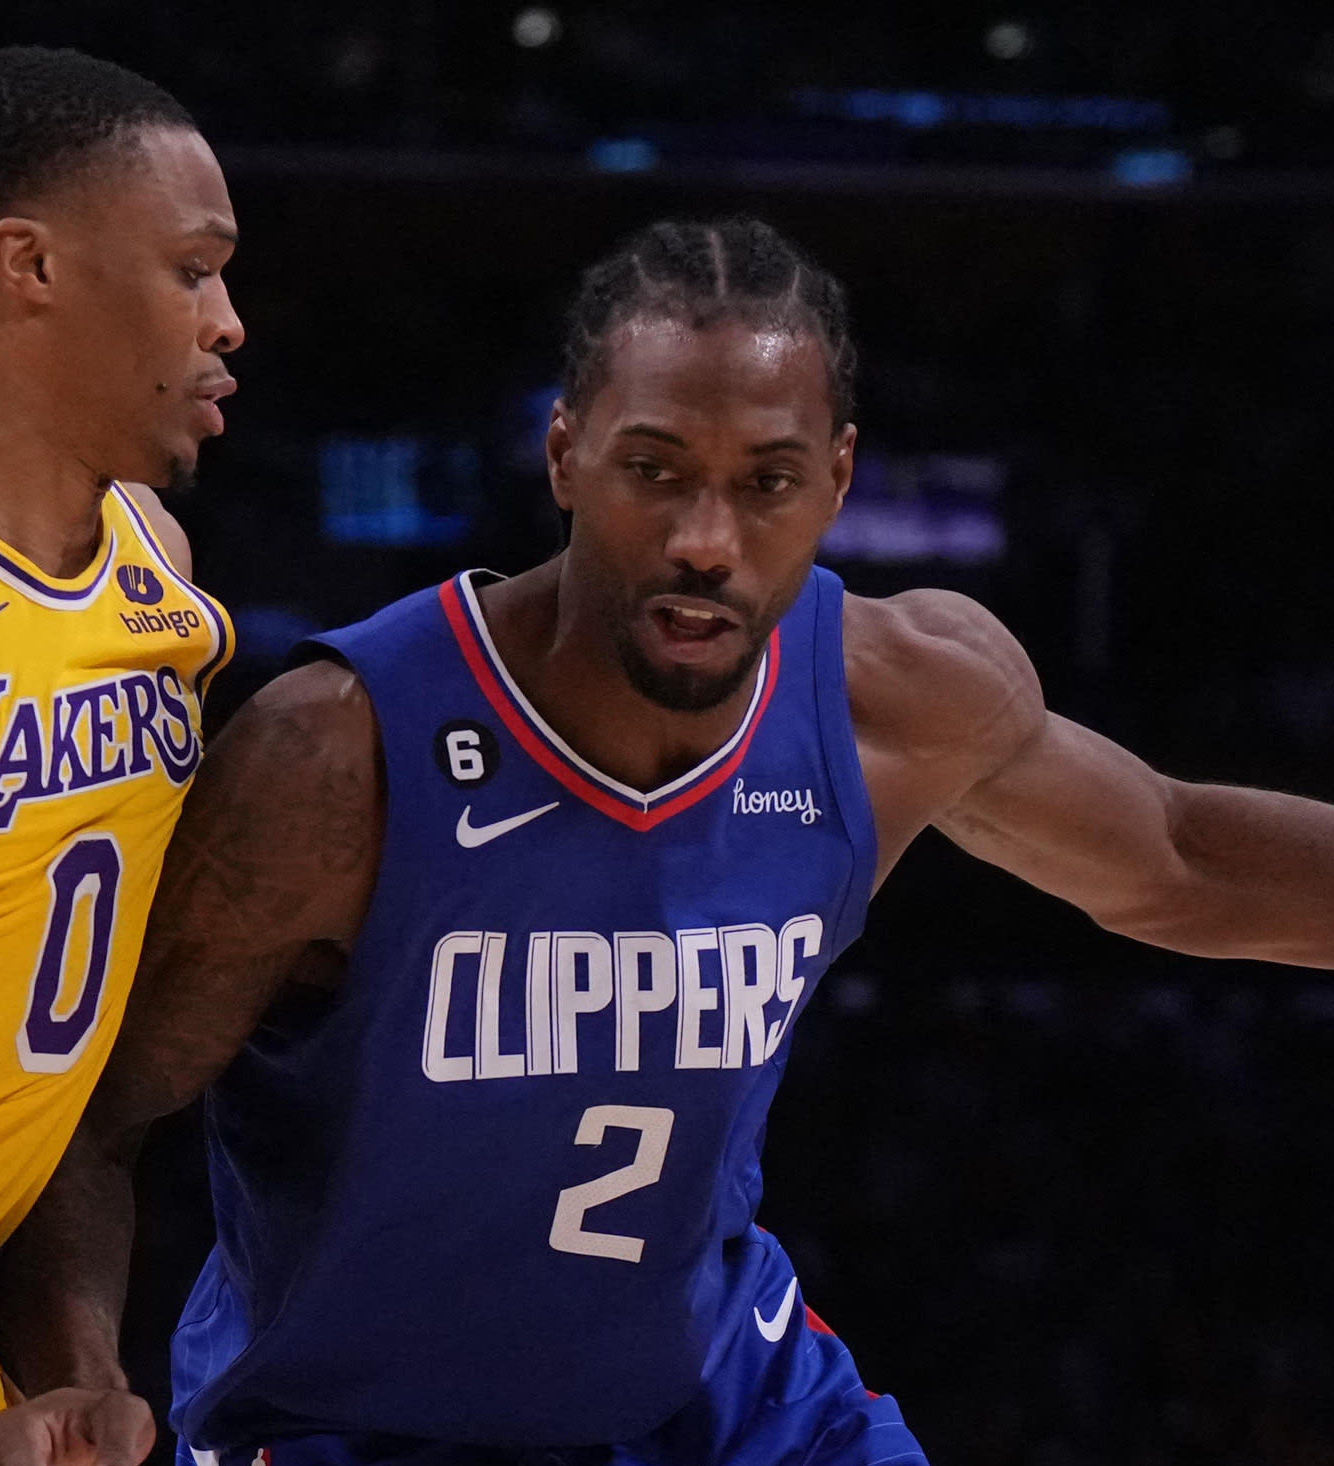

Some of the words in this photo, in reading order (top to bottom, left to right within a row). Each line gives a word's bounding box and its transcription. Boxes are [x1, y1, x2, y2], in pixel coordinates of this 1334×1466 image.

[119, 608, 200, 638] bibigo
[446, 729, 485, 781] 6
[733, 778, 822, 824] honey
[15, 832, 124, 1074] 0
[422, 914, 824, 1082] CLIPPERS
[549, 1105, 675, 1264] 2
